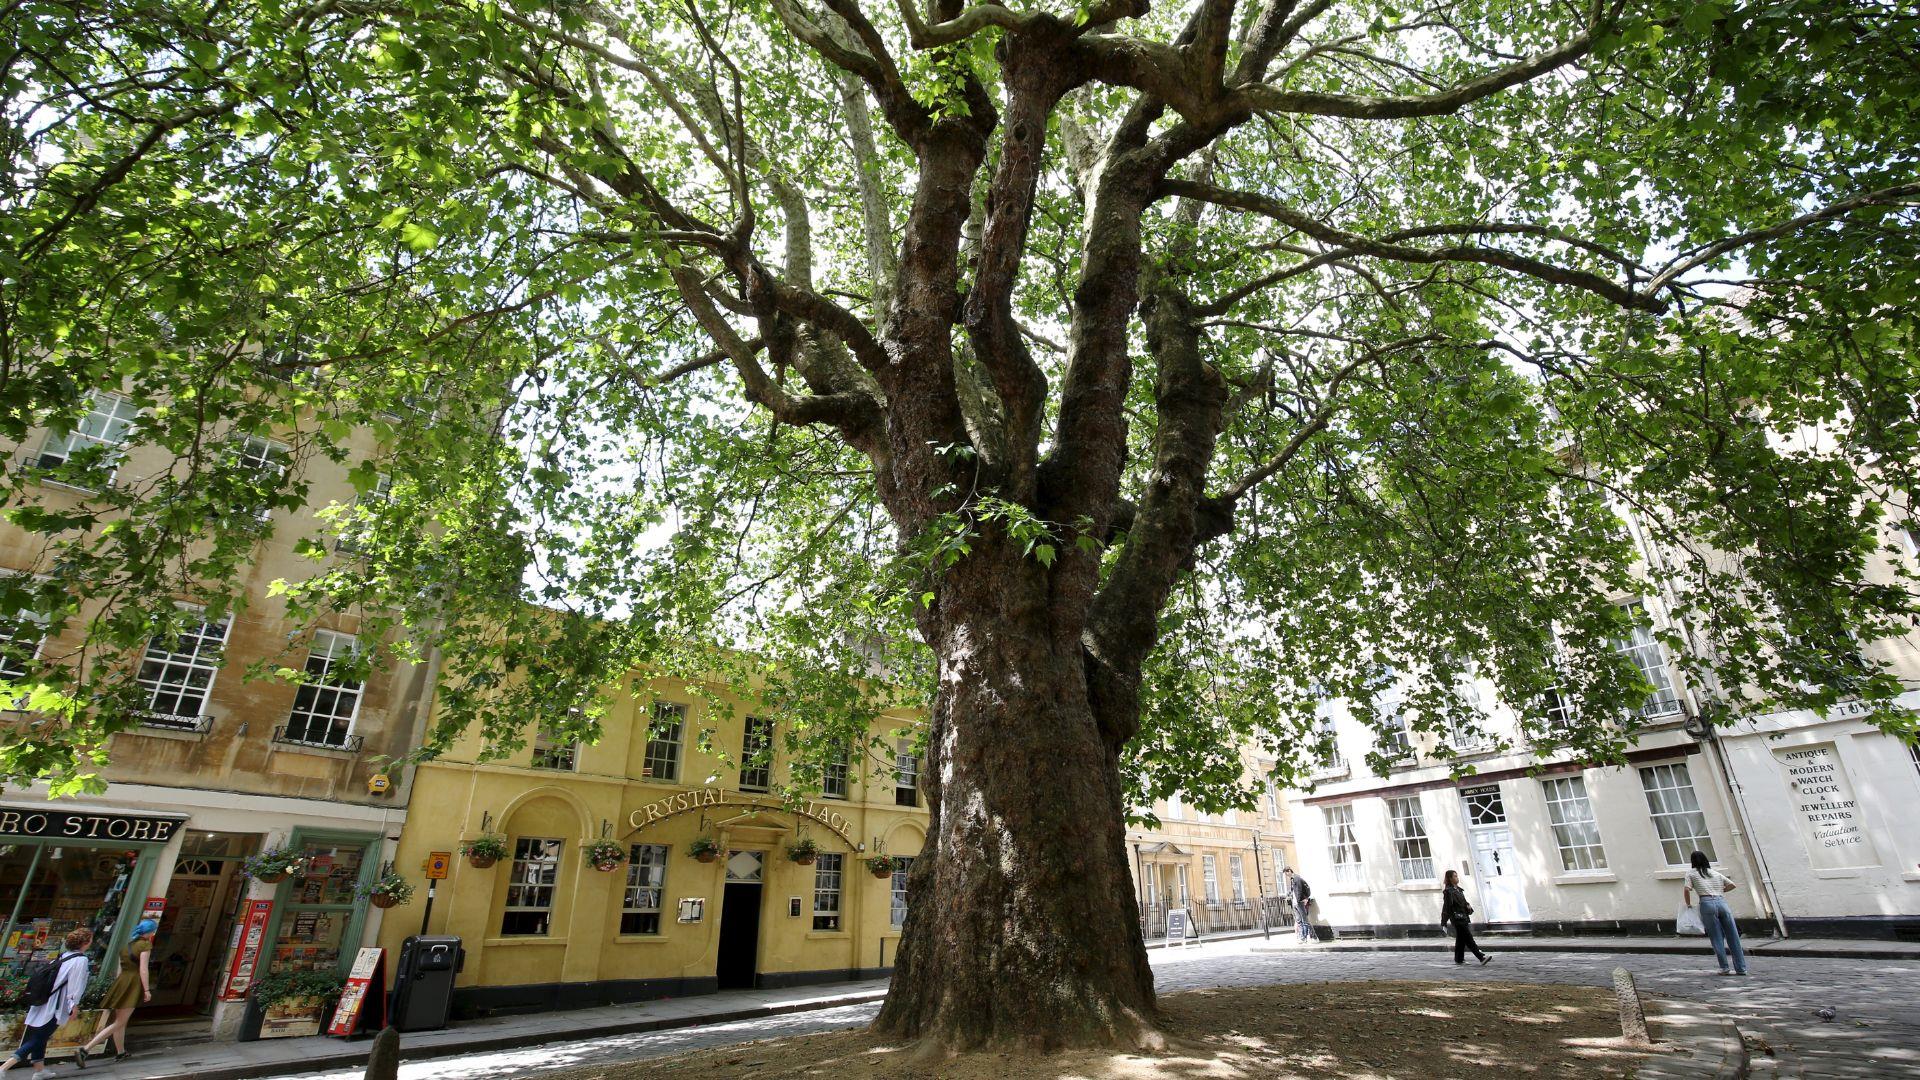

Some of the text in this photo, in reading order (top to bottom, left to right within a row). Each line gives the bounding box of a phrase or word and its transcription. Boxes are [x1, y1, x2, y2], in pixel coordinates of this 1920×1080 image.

[1786, 748, 1829, 761] ANTIQUE
[1789, 763, 1835, 776] MODERN
[1797, 774, 1833, 785] WATCH
[1802, 784, 1840, 795] CLOCK
[628, 787, 730, 829] CRYSTAL
[1800, 800, 1855, 812] JEWELLERY
[1808, 811, 1852, 822] REPAIRS
[63, 816, 173, 840] STORE
[1813, 825, 1858, 840] Valuation
[1824, 835, 1862, 848] Service
